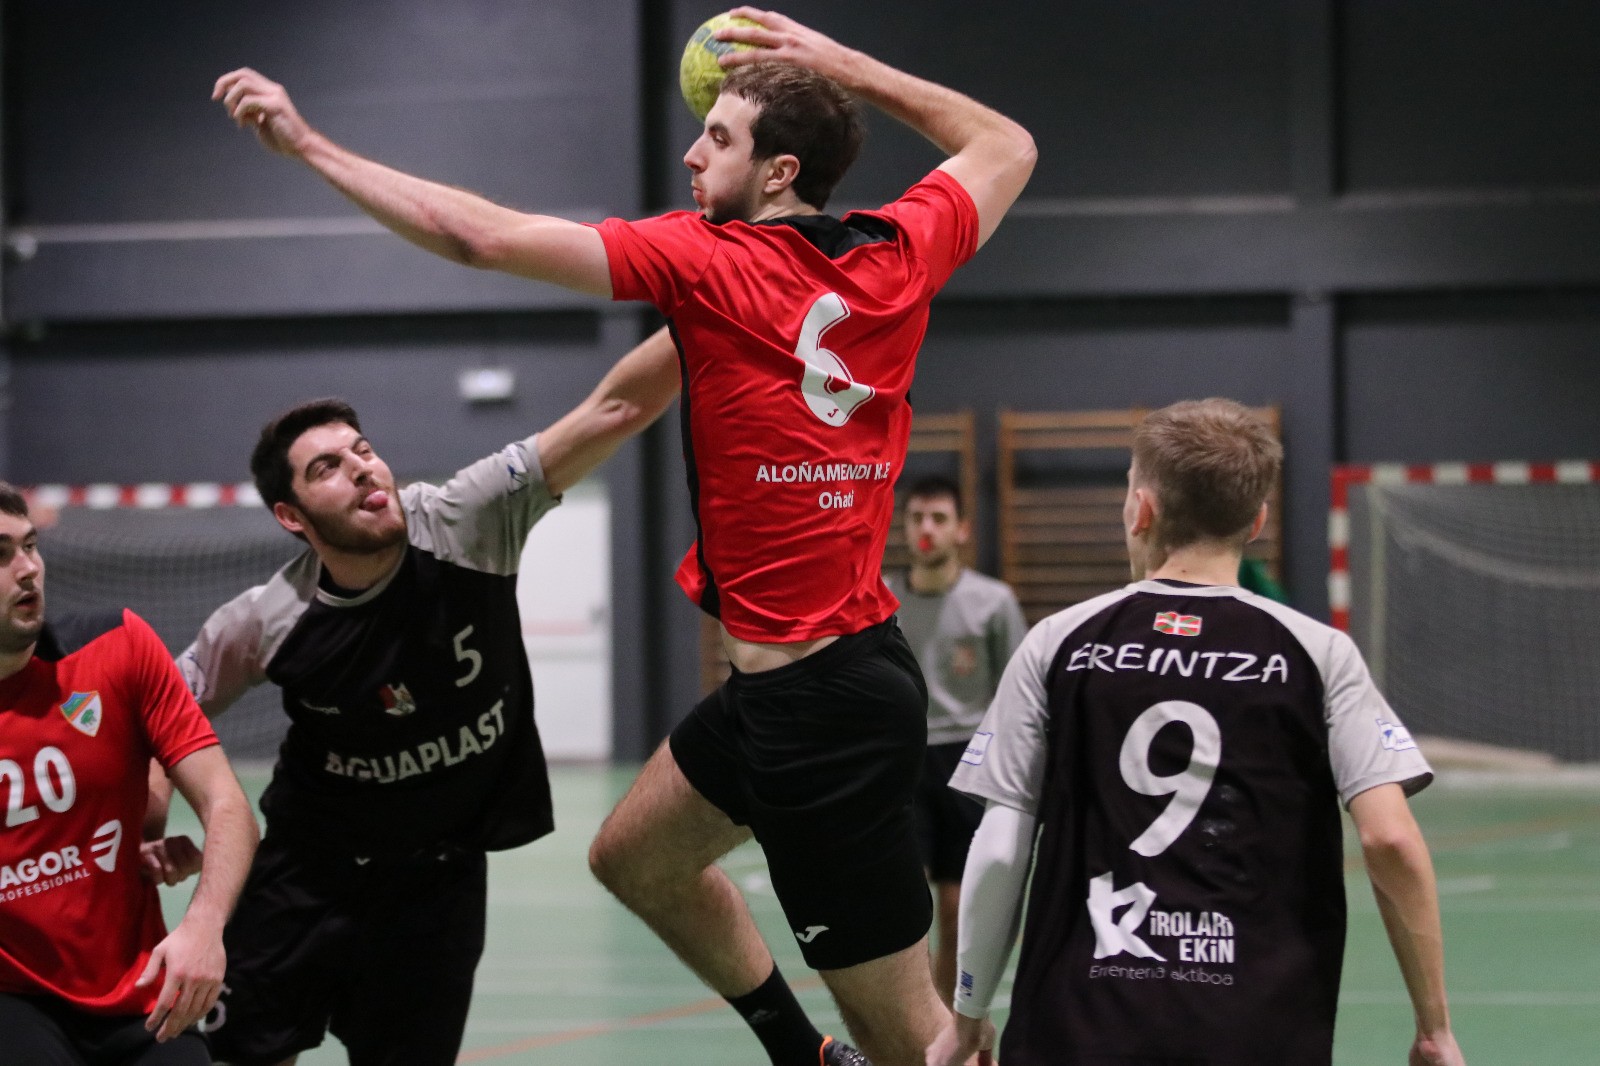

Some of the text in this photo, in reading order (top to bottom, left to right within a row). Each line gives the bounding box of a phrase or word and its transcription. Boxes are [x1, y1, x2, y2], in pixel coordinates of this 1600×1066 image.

[794, 291, 876, 427] 6
[756, 461, 872, 483] ALOÑAMENDI
[818, 489, 855, 510] Oñati
[453, 625, 483, 688] 5
[1066, 643, 1289, 684] EREINTZA
[0, 745, 77, 828] 20
[1119, 700, 1222, 858] 9
[0, 845, 83, 890] AGOR
